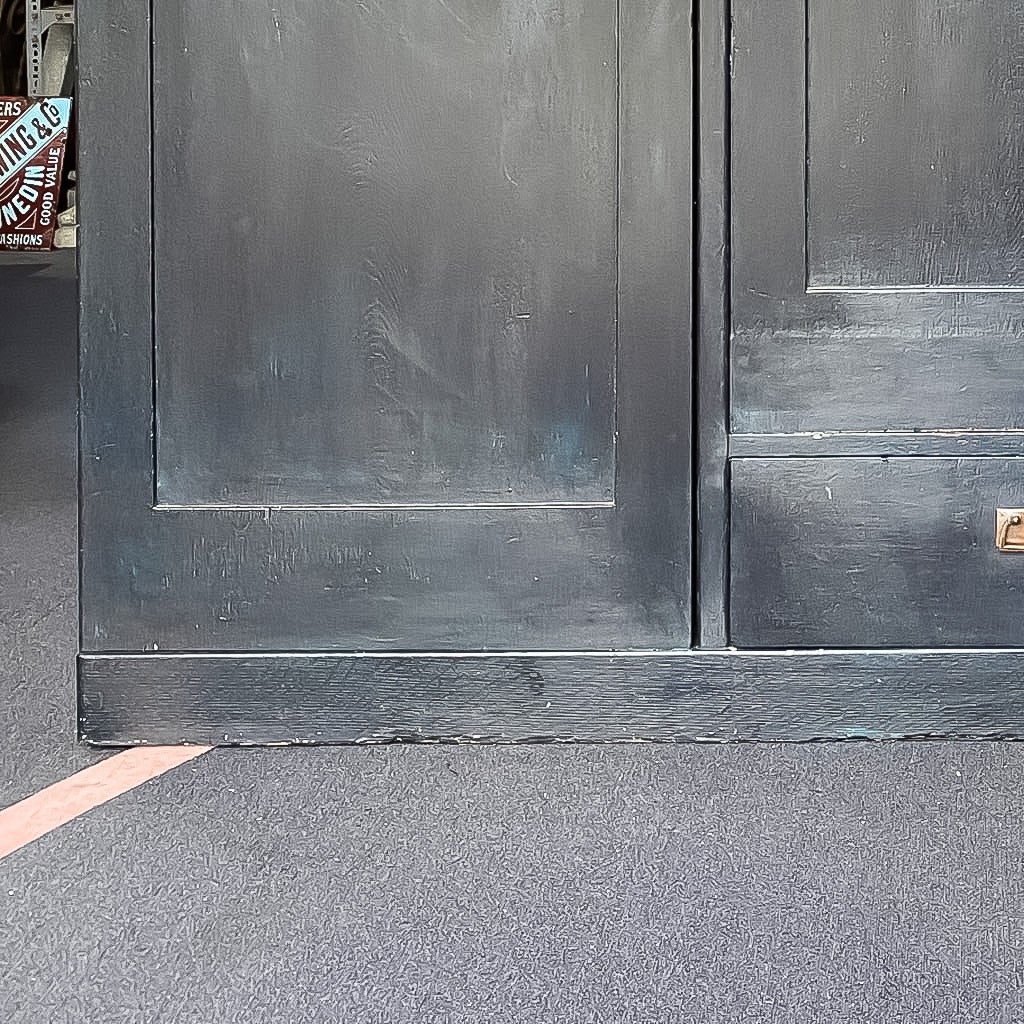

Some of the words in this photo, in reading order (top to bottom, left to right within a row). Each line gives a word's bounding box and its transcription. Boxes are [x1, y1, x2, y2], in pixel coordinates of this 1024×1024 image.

[31, 117, 53, 140] &
[44, 147, 61, 188] VALUE
[39, 191, 54, 226] GOOD
